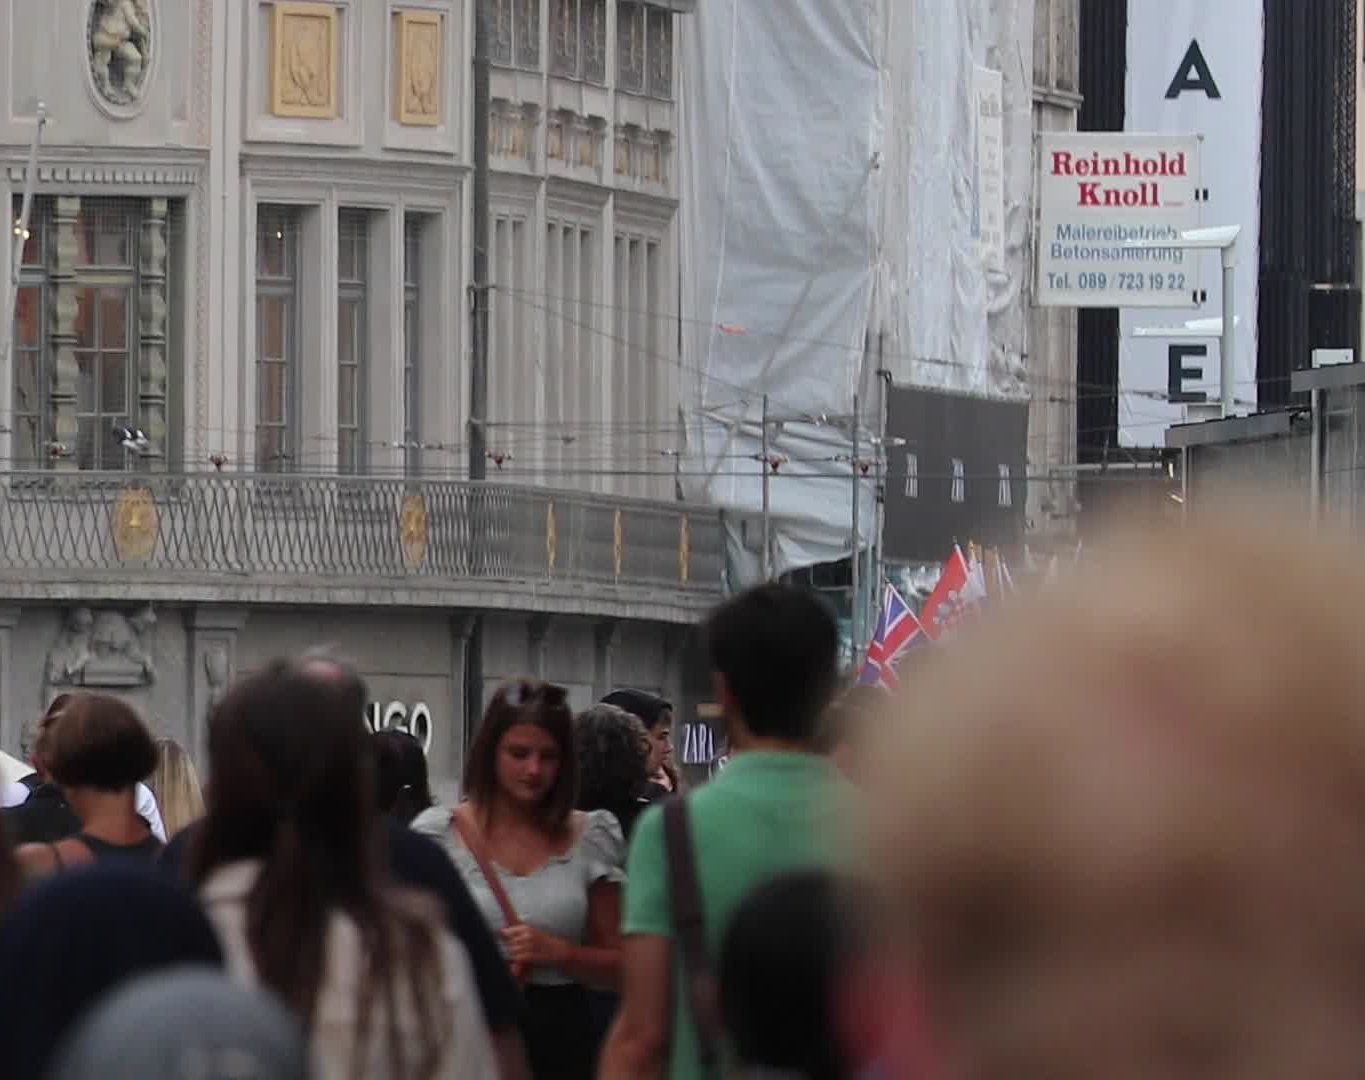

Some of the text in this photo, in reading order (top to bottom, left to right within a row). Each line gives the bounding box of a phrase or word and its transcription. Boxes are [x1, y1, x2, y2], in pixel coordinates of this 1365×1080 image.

[1164, 37, 1221, 99] A
[1051, 151, 1186, 176] Reinhold
[1077, 182, 1159, 207] Knoll
[1056, 224, 1178, 241] Malereibetrieb
[1051, 243, 1184, 264] Betonsanierung
[1048, 272, 1071, 289] Tel.
[1149, 272, 1164, 289] 19
[1168, 272, 1186, 289] 22
[1168, 344, 1207, 402] E
[683, 723, 714, 763] ZARA
